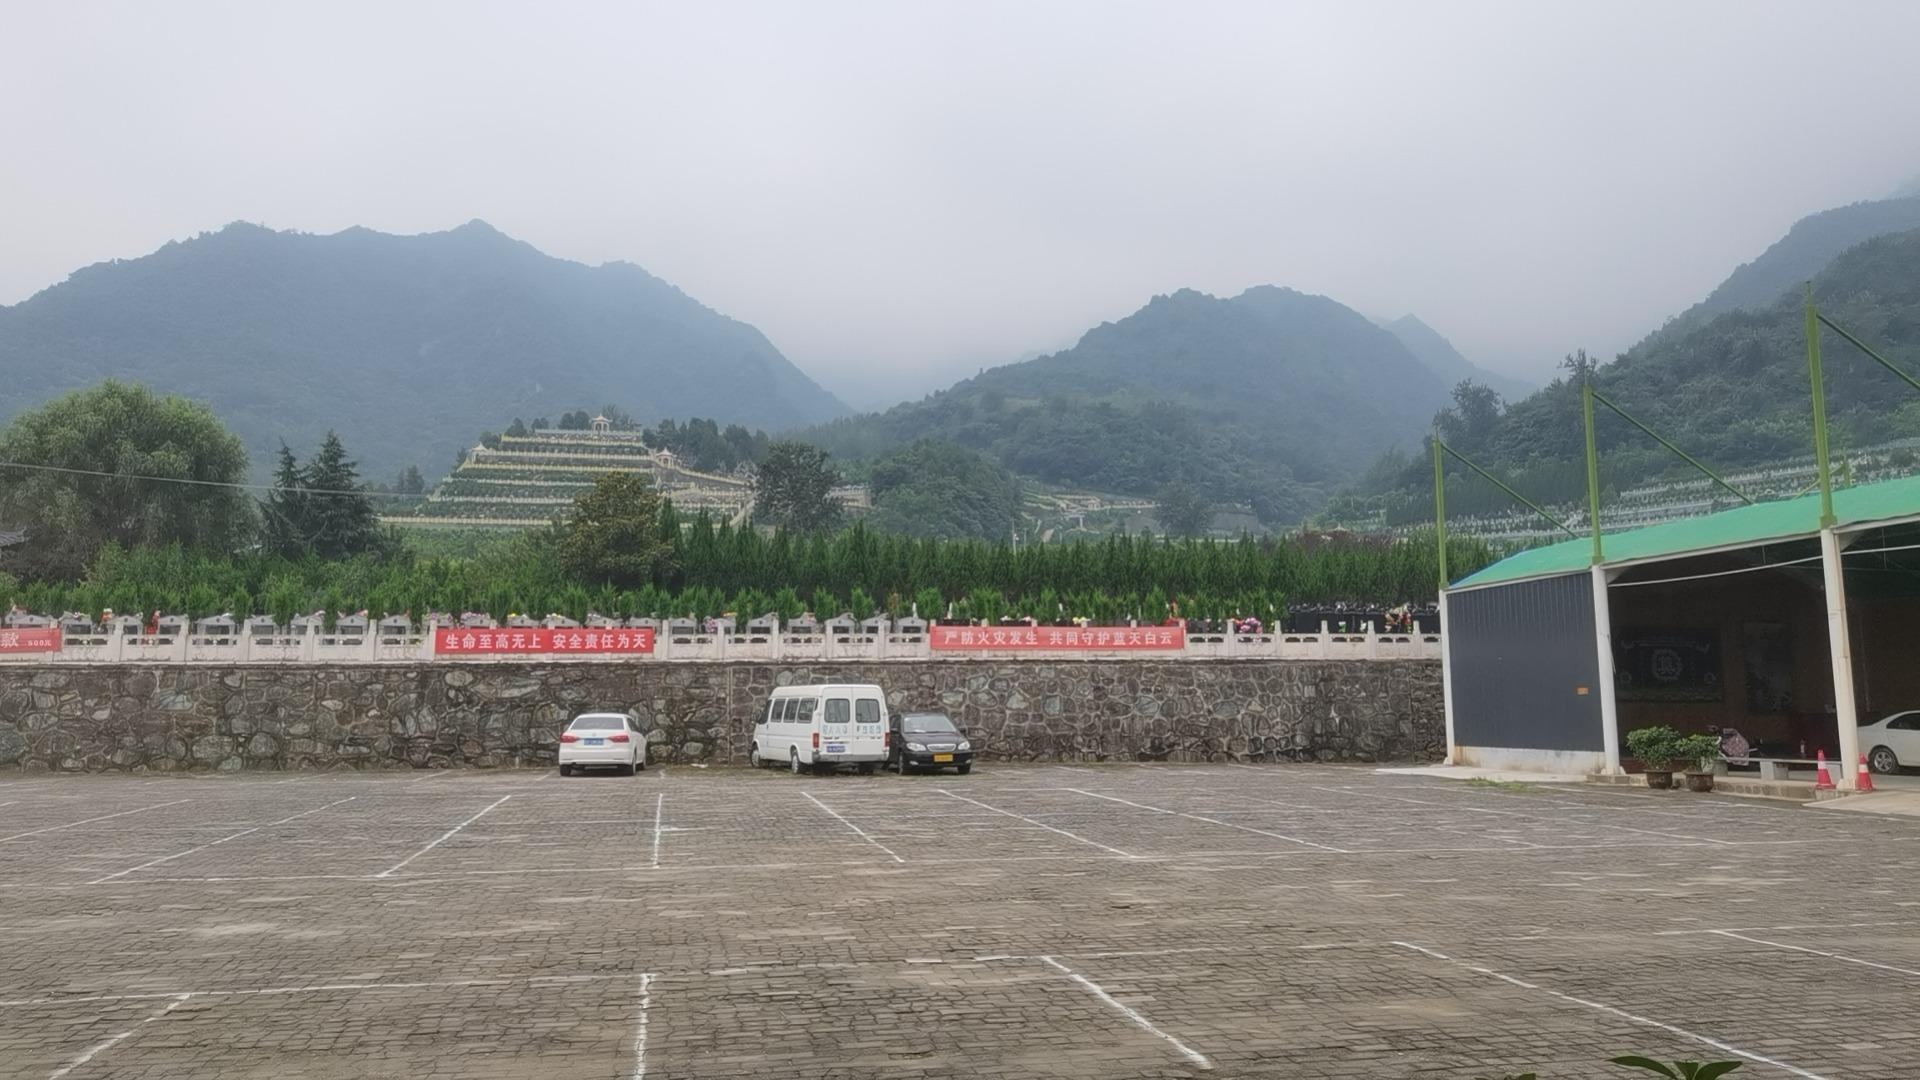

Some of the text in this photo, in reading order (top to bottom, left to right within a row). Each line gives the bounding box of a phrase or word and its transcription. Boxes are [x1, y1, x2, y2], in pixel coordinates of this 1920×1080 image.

[445, 633, 647, 649] 生命至高无上 安全责任为天
[944, 630, 1172, 645] 严防火灾发生 共同守护蓝天白云
